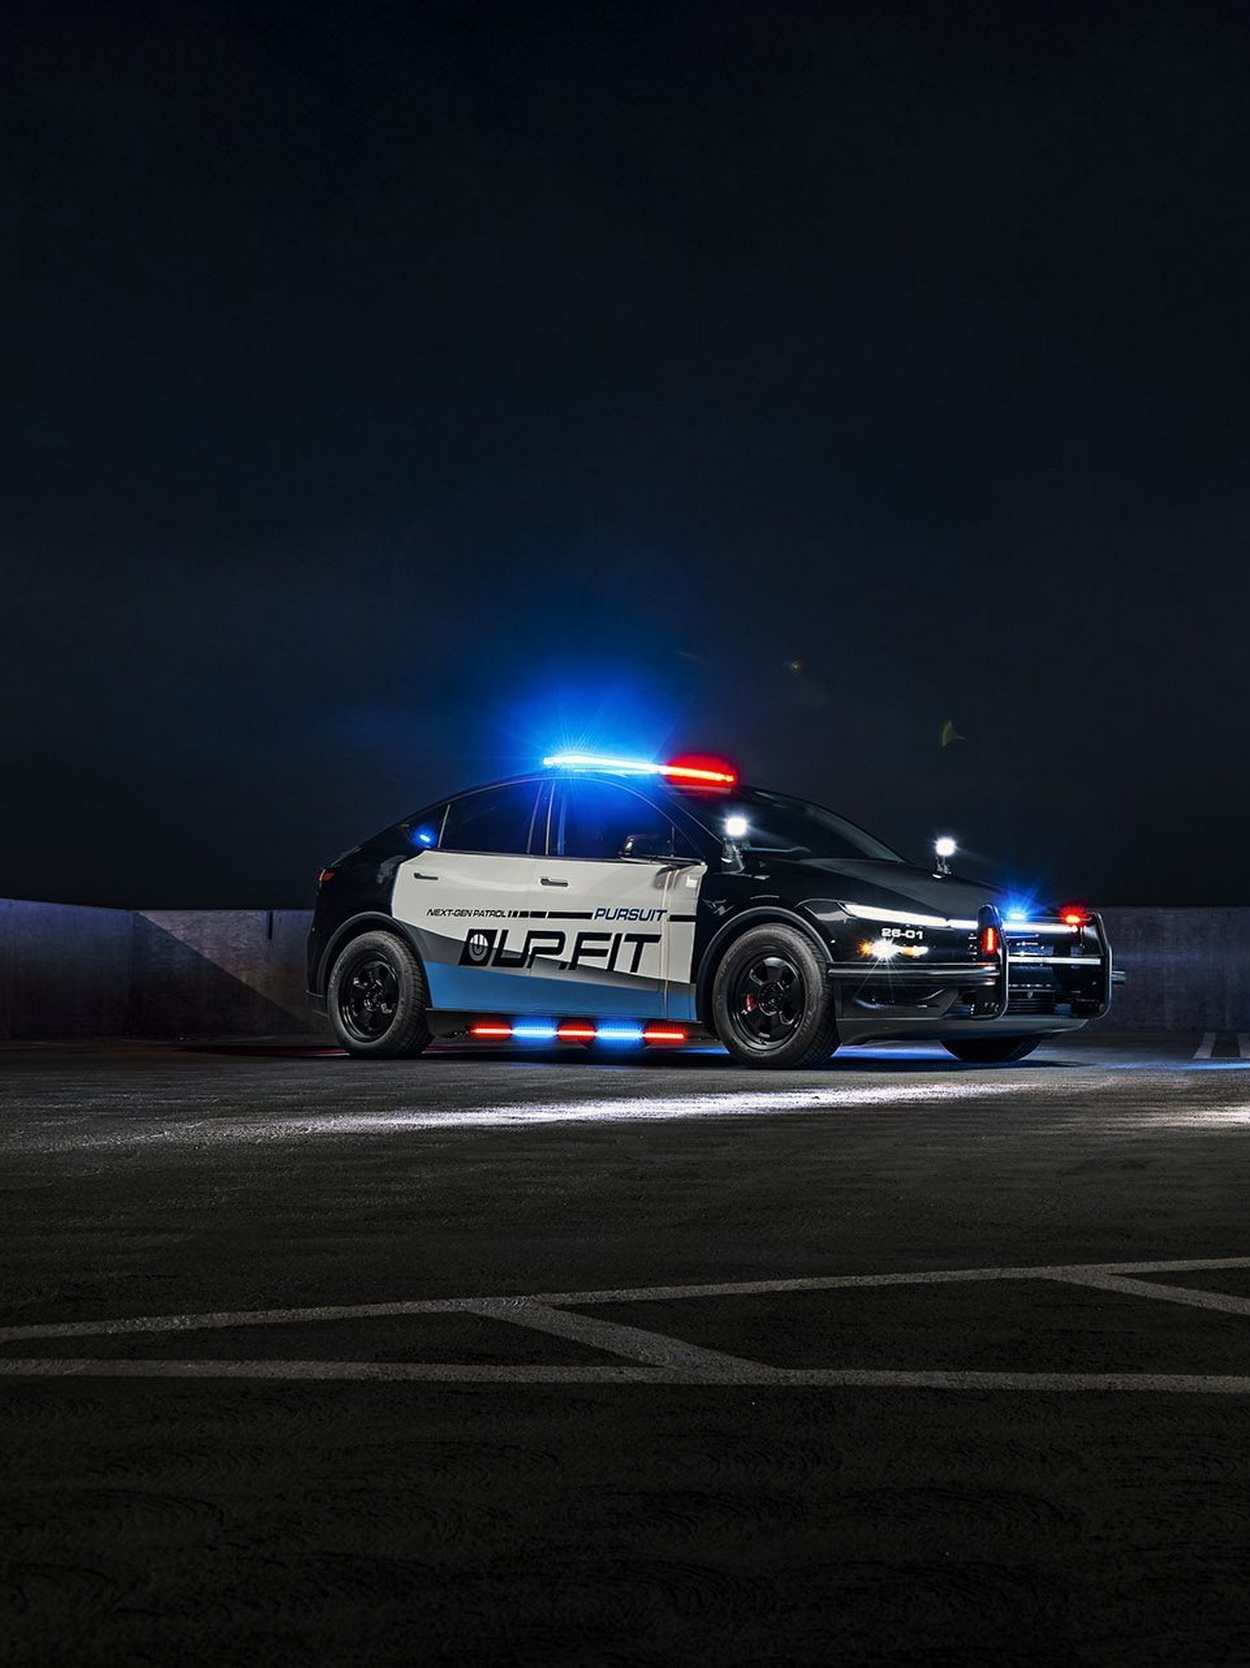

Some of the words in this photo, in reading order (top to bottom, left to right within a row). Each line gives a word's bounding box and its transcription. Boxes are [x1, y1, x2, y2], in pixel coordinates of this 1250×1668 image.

[426, 908, 472, 918] NEXT-GEN
[473, 909, 507, 918] PATROL
[594, 908, 668, 921] PURSUIT
[881, 928, 923, 939] 26-01
[491, 929, 662, 973] UP.FIT
